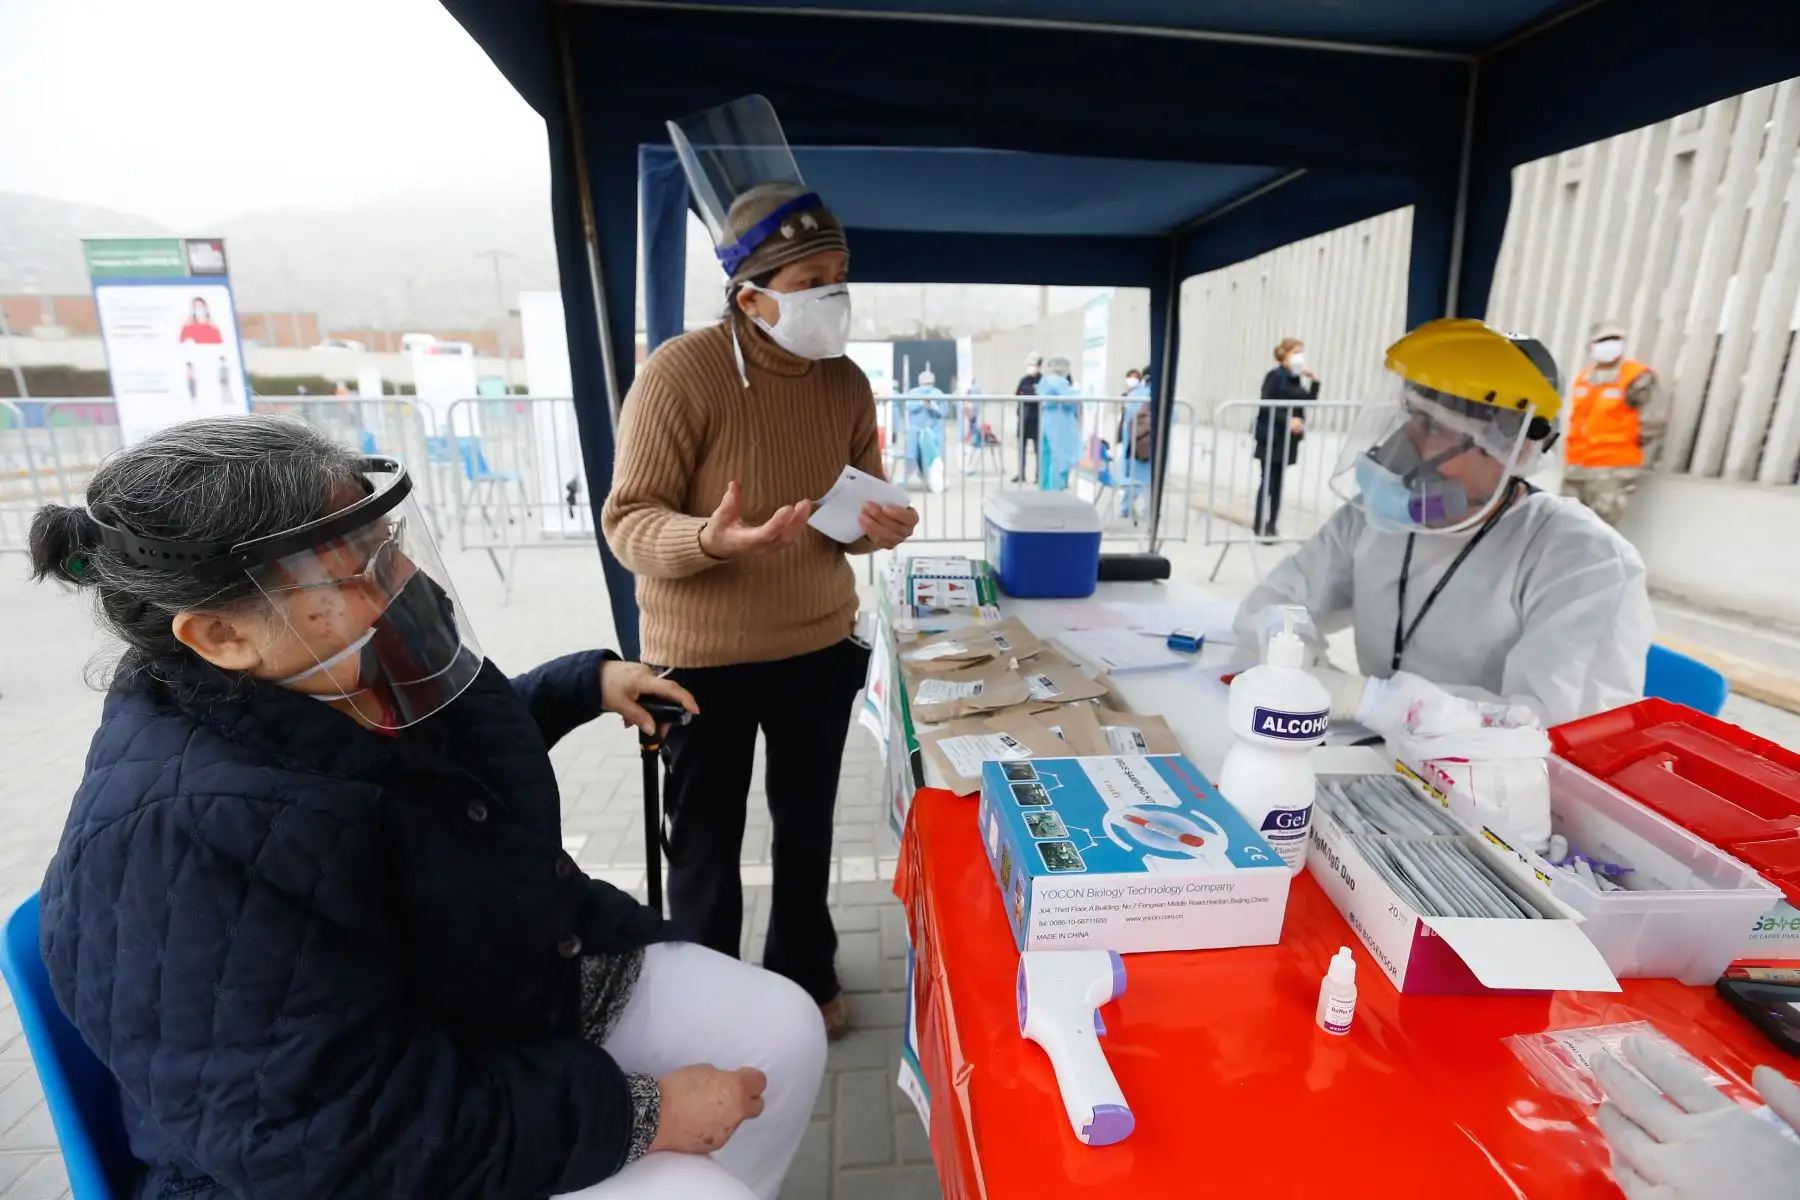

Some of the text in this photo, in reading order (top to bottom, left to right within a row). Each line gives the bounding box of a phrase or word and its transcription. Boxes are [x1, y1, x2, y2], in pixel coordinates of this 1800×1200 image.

[1276, 810, 1306, 828] Gel
[1314, 831, 1341, 870] IgM/IgG
[1340, 864, 1356, 891] Duo
[1040, 883, 1235, 900] YOCON Biology Technology Company
[1388, 903, 1399, 918] 20
[1362, 930, 1398, 978] BIOSENSOR
